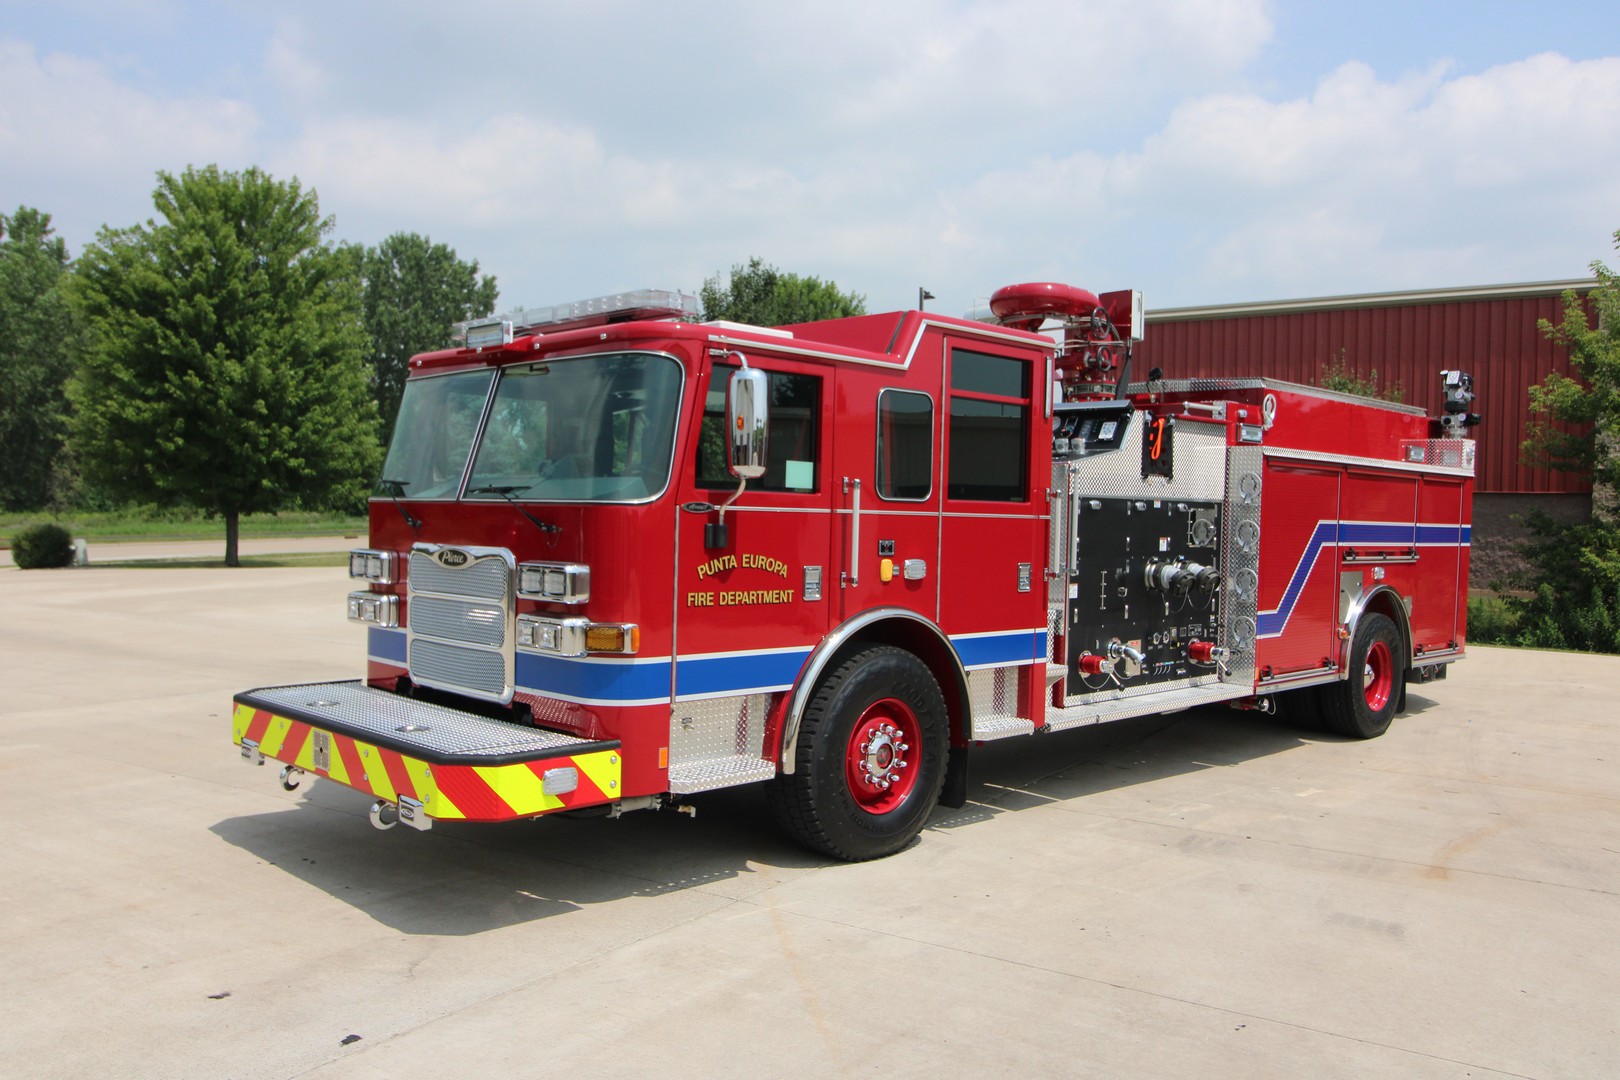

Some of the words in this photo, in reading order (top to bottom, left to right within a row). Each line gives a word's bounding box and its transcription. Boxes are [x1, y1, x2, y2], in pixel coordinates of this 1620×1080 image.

[442, 549, 464, 564] Pierce
[697, 555, 738, 580] PUNTA
[742, 554, 788, 579] EUROPA
[687, 592, 714, 607] FIRE
[719, 589, 795, 606] DEPARTMENT
